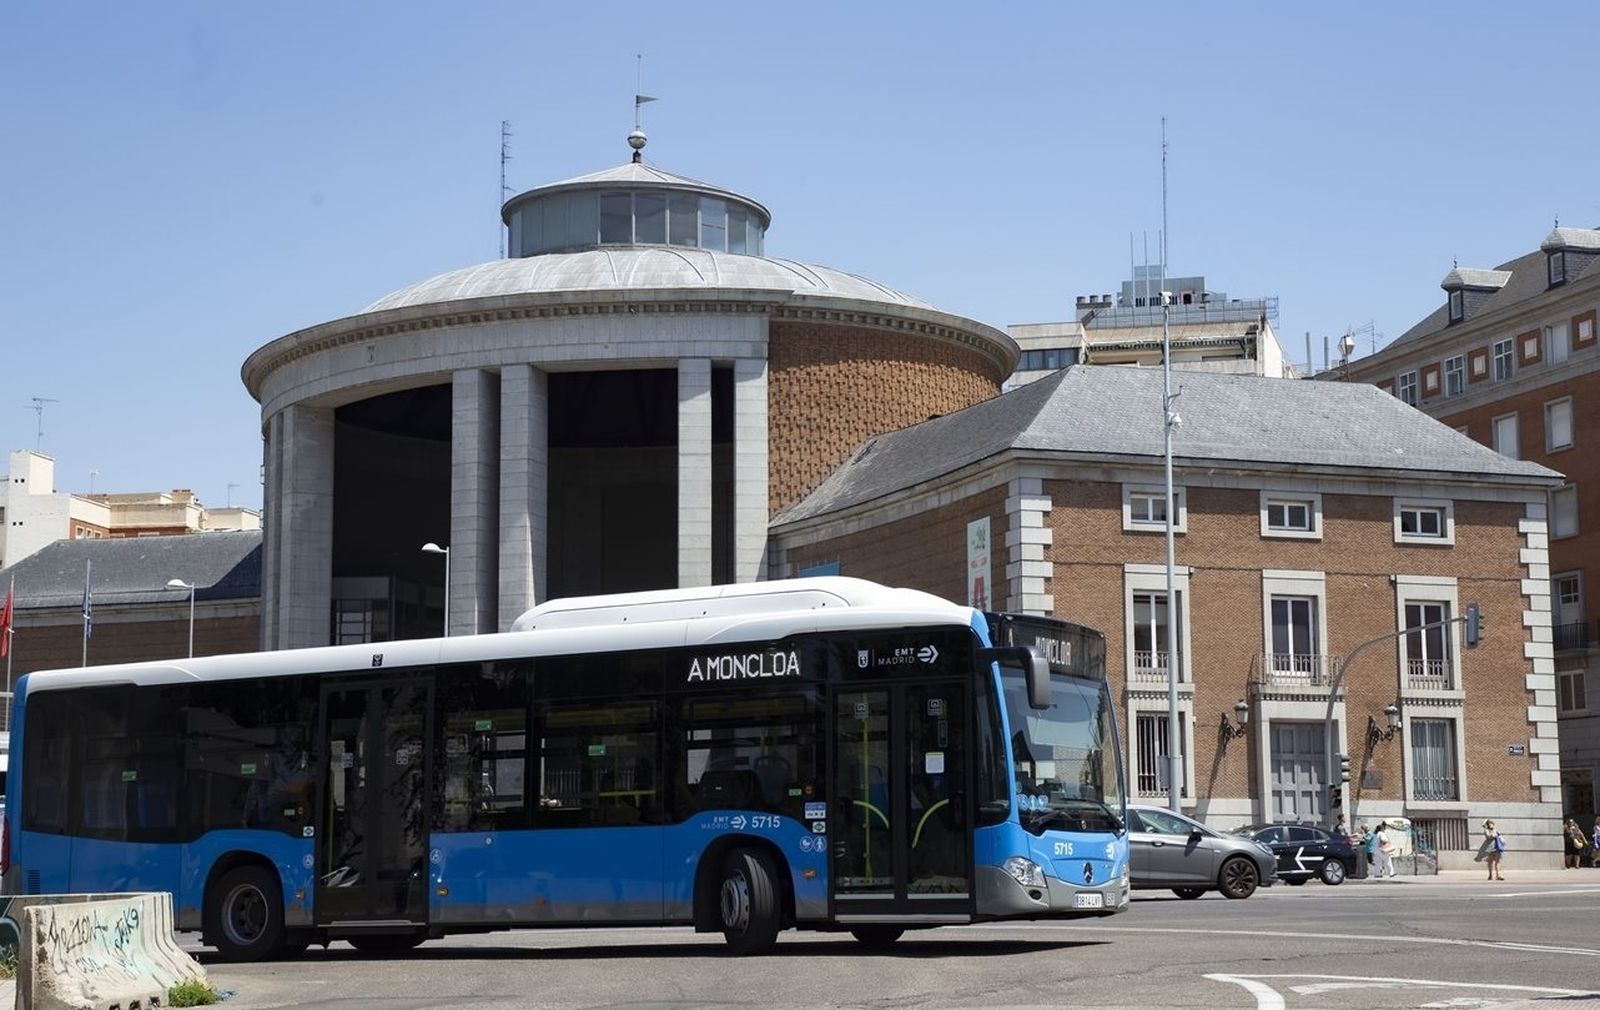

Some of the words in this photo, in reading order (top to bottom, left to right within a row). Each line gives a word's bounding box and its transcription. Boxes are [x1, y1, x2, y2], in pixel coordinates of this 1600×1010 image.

[895, 648, 915, 657] EMT
[687, 658, 704, 682] A
[706, 651, 800, 681] MONCLOA
[878, 655, 915, 666] MADRID
[751, 816, 781, 829] 5715
[1054, 842, 1073, 856] 5715
